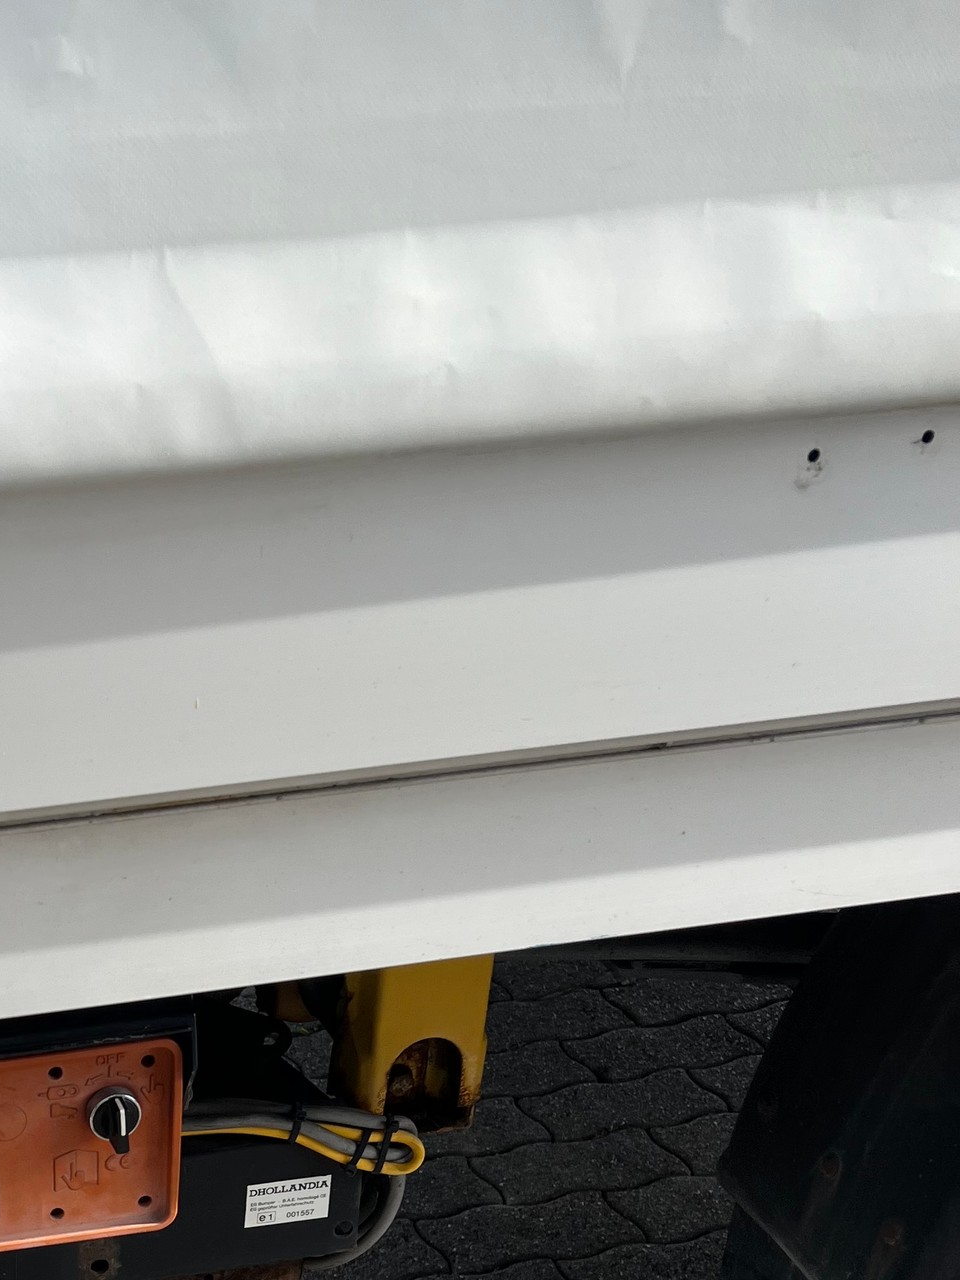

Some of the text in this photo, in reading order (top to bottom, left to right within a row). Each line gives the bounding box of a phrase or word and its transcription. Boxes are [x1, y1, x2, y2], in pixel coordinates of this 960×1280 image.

[96, 1052, 125, 1066] OFF
[249, 1180, 329, 1197] DHOLLANDIA
[286, 1208, 315, 1218] 001557
